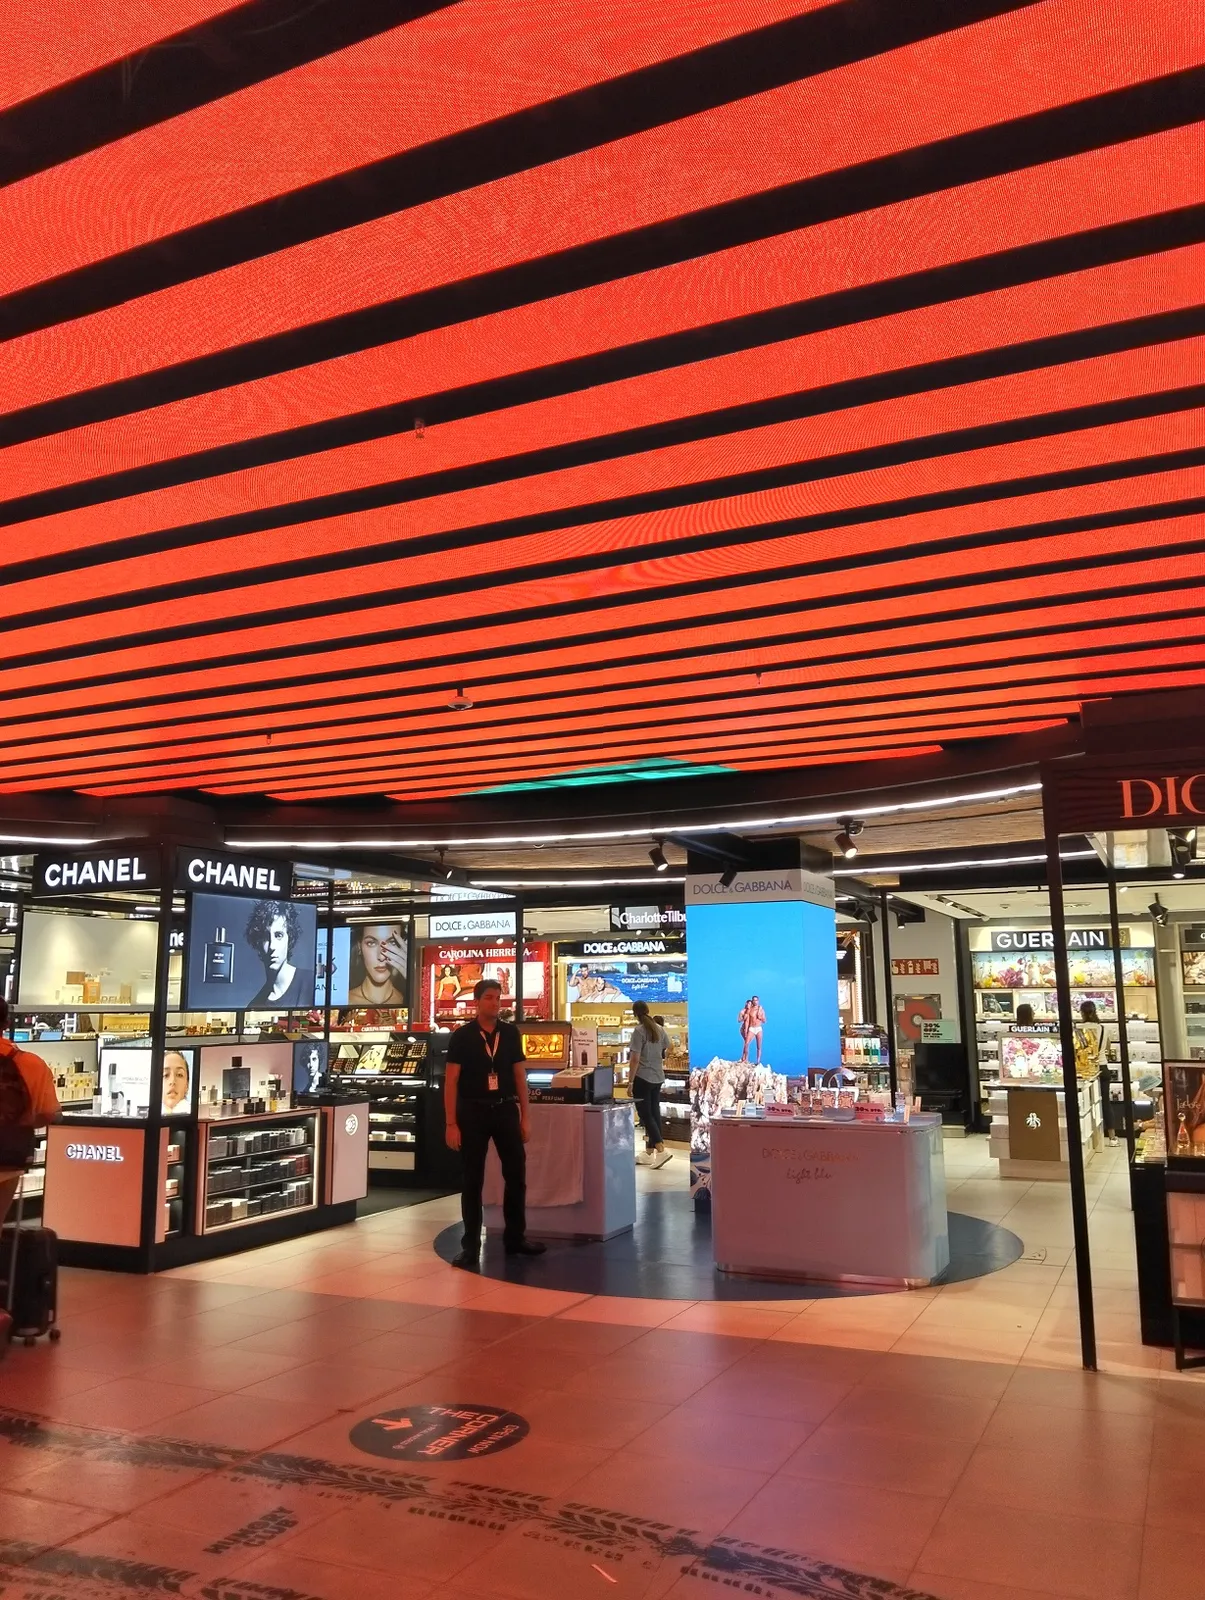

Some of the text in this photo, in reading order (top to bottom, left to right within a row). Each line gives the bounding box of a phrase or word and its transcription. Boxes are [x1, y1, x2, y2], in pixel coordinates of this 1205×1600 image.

[44, 857, 147, 887] CHANEL
[188, 858, 281, 892] CHANEL
[734, 880, 793, 893] GABBANA
[467, 919, 511, 930] GABBANA
[996, 930, 1105, 949] GUERAIN
[439, 948, 530, 959] CAROLINA HERREA
[1010, 1025, 1050, 1033] GUERLAIN
[66, 1143, 124, 1162] CHANEL
[417, 1414, 499, 1455] CORNER
